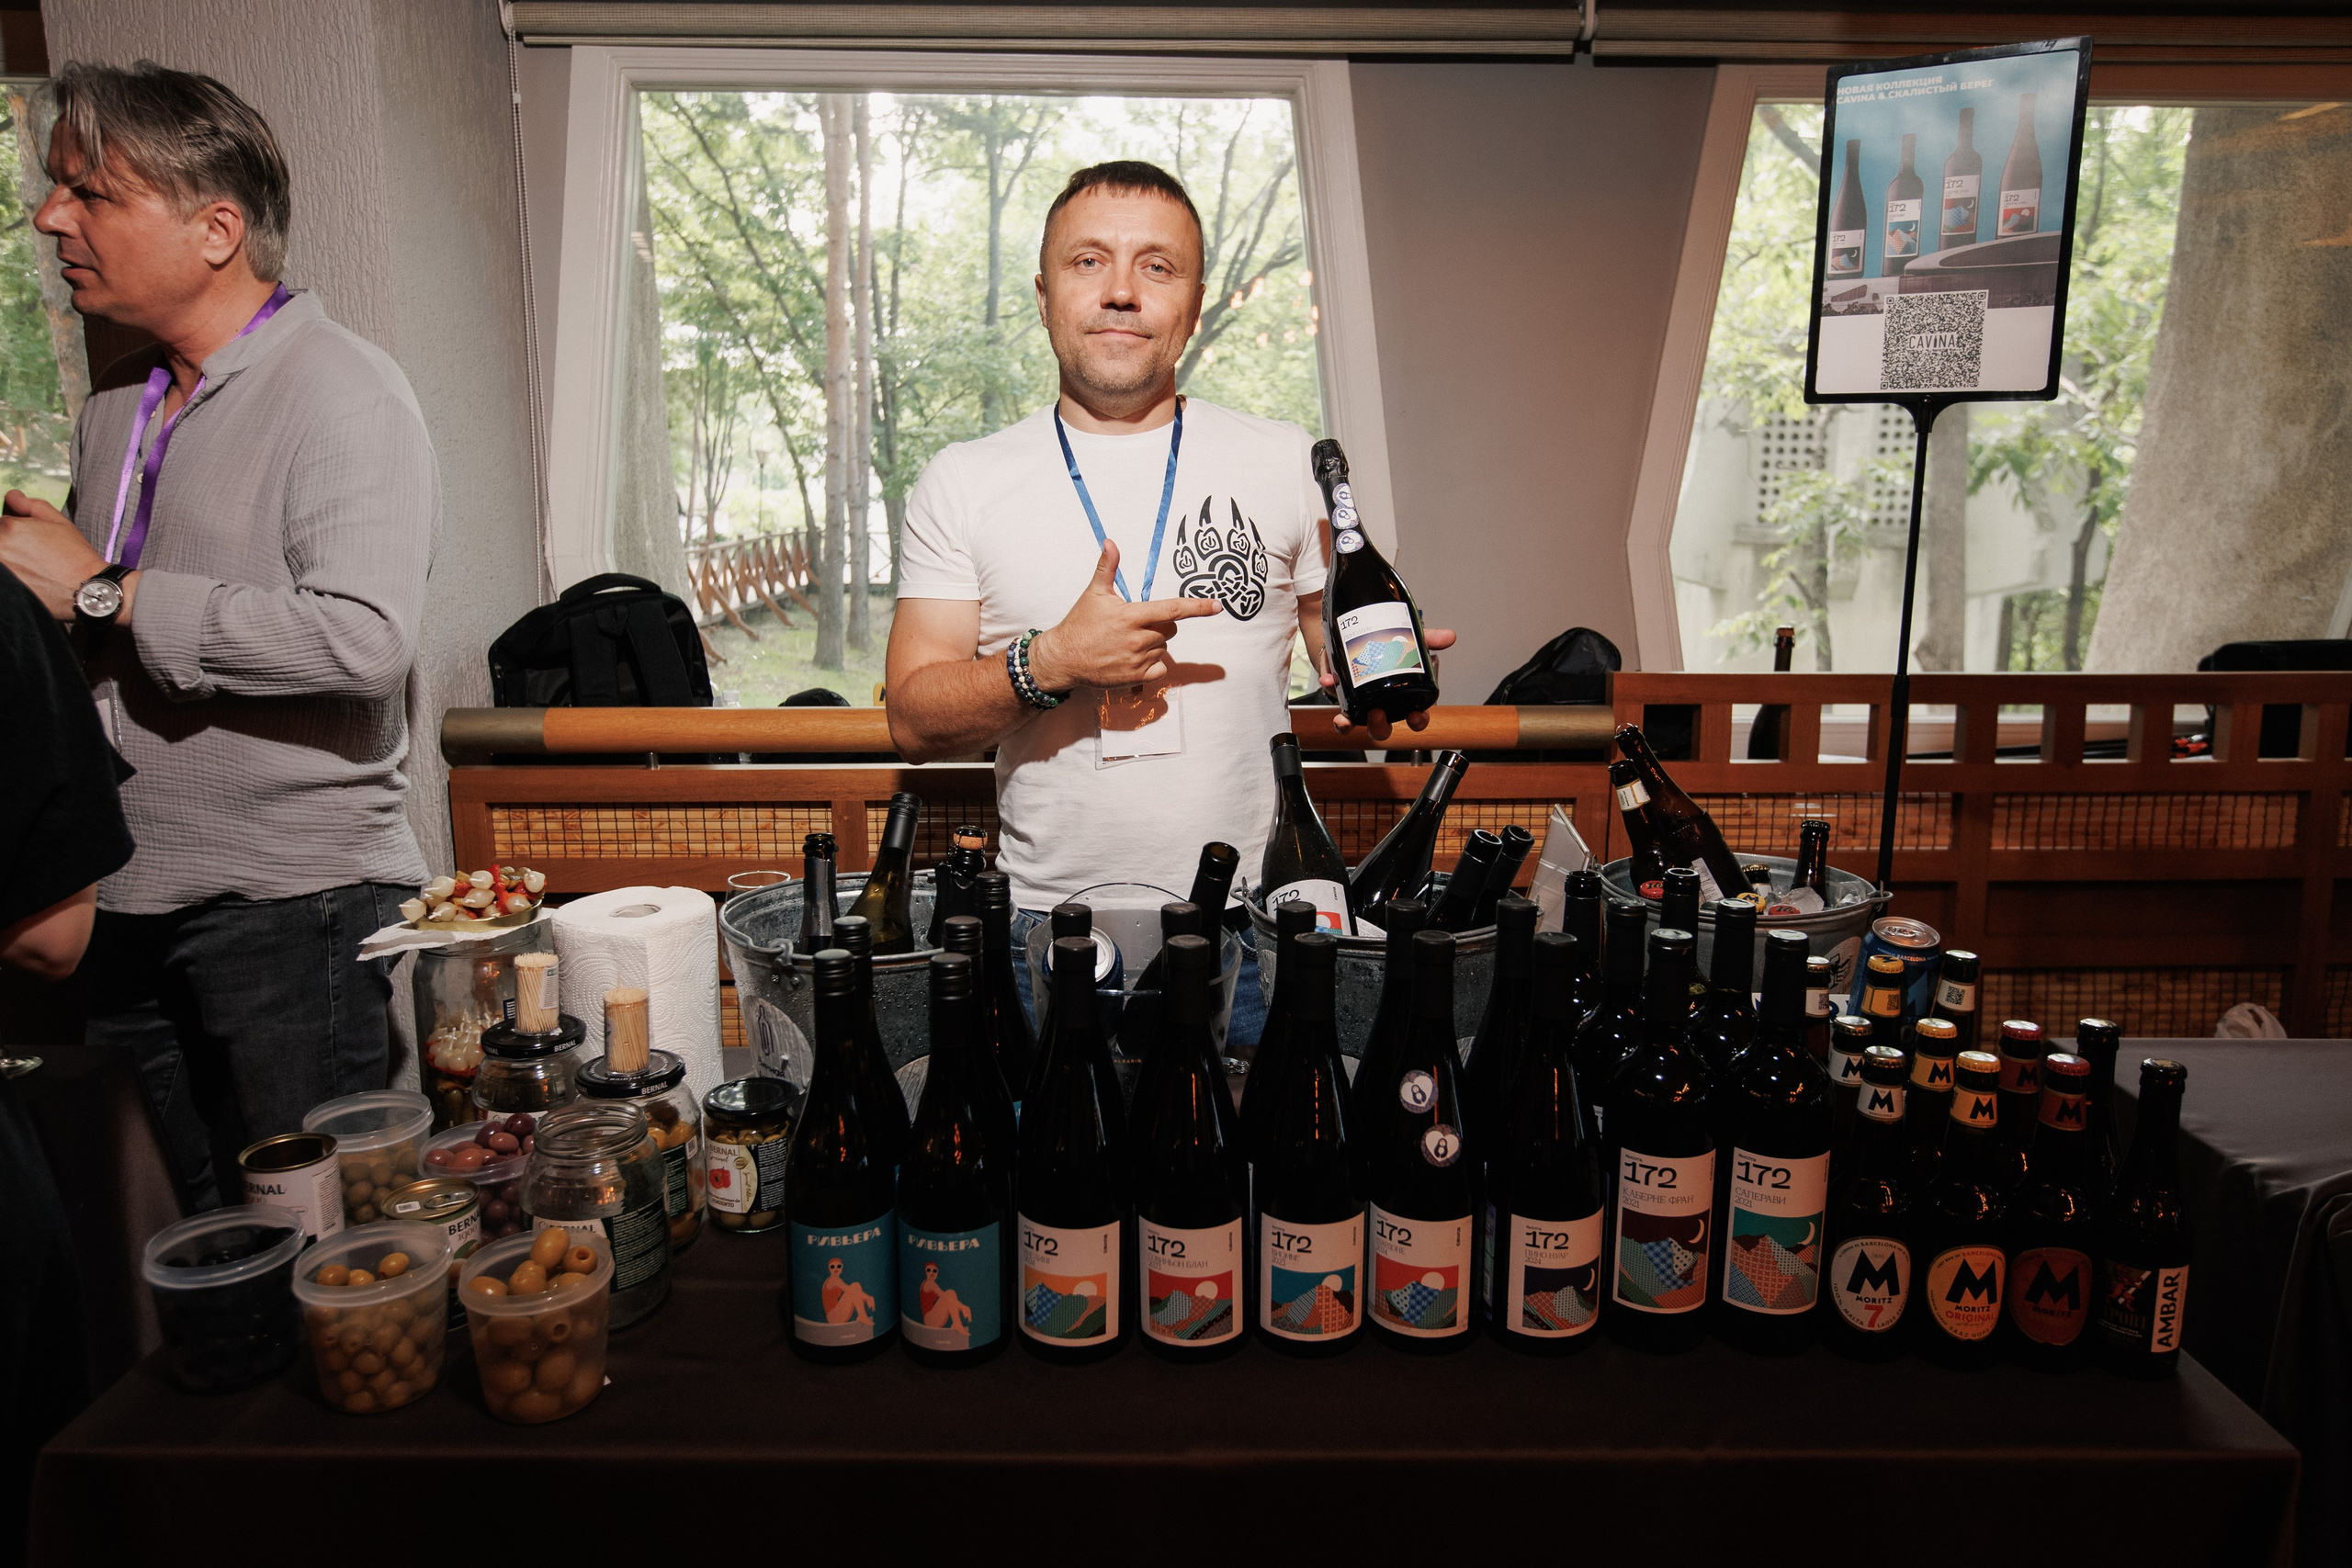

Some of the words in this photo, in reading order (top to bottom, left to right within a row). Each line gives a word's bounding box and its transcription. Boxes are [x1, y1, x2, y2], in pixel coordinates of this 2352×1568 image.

[1836, 93, 1876, 105] CAVINA
[1887, 82, 1958, 99] СКАЛИСТЫЙ
[1960, 79, 1995, 91] БЕРЕГ
[1837, 84, 1873, 96] НОВАЯ
[1875, 75, 1943, 91] КОЛЛЕКЦИЯ
[1945, 179, 1963, 189] 172
[2004, 194, 2019, 202] 172
[1889, 203, 1906, 213] 172
[1832, 234, 1846, 243] 172
[1908, 333, 1955, 349] CAVINA
[1340, 615, 1359, 631] 172
[553, 1039, 577, 1053] BERNAL
[1927, 1061, 1951, 1084] M
[2017, 1066, 2037, 1087] M
[641, 1081, 669, 1095] BERNAL
[1867, 1088, 1894, 1113] M
[1969, 1096, 1995, 1120] M
[2055, 1099, 2082, 1124] M
[709, 1144, 738, 1156] BERNAL
[1623, 1161, 1678, 1189] 172
[1736, 1161, 1792, 1190] 172
[1622, 1195, 1640, 1208] 2021
[1623, 1186, 1667, 1204] КАБЕРНЕ
[1668, 1194, 1694, 1205] ФРАН
[1734, 1195, 1753, 1208] 2021
[1735, 1186, 1787, 1205] САПЕРАВИ
[807, 1226, 882, 1247] РИВЬЕРА
[1272, 1231, 1312, 1254] 172
[1376, 1220, 1412, 1247] 172
[1525, 1231, 1569, 1250] 172
[908, 1234, 980, 1252] РИВЬЕРА
[1023, 1230, 1058, 1257] 172
[1148, 1235, 1186, 1258] 172
[1860, 1241, 1897, 1250] BARCELONA
[1271, 1247, 1300, 1262] ВИОНЬЕ
[1524, 1248, 1548, 1258] ПИНО
[1548, 1251, 1569, 1259] НУАР
[1524, 1256, 1542, 1265] 2024
[1186, 1259, 1208, 1269] БЛАН
[1846, 1248, 1901, 1297] M
[1945, 1258, 1997, 1305] M
[2023, 1259, 2081, 1311] M
[1855, 1295, 1893, 1304] MORITZ
[1954, 1304, 1991, 1313] MORITZ
[1842, 1308, 1864, 1326] MALTA
[1863, 1303, 1884, 1328] 7
[1945, 1310, 1995, 1322] ORIGINAL
[2156, 1271, 2181, 1348] AMBAR
[1949, 1325, 1969, 1337] SAAZ
